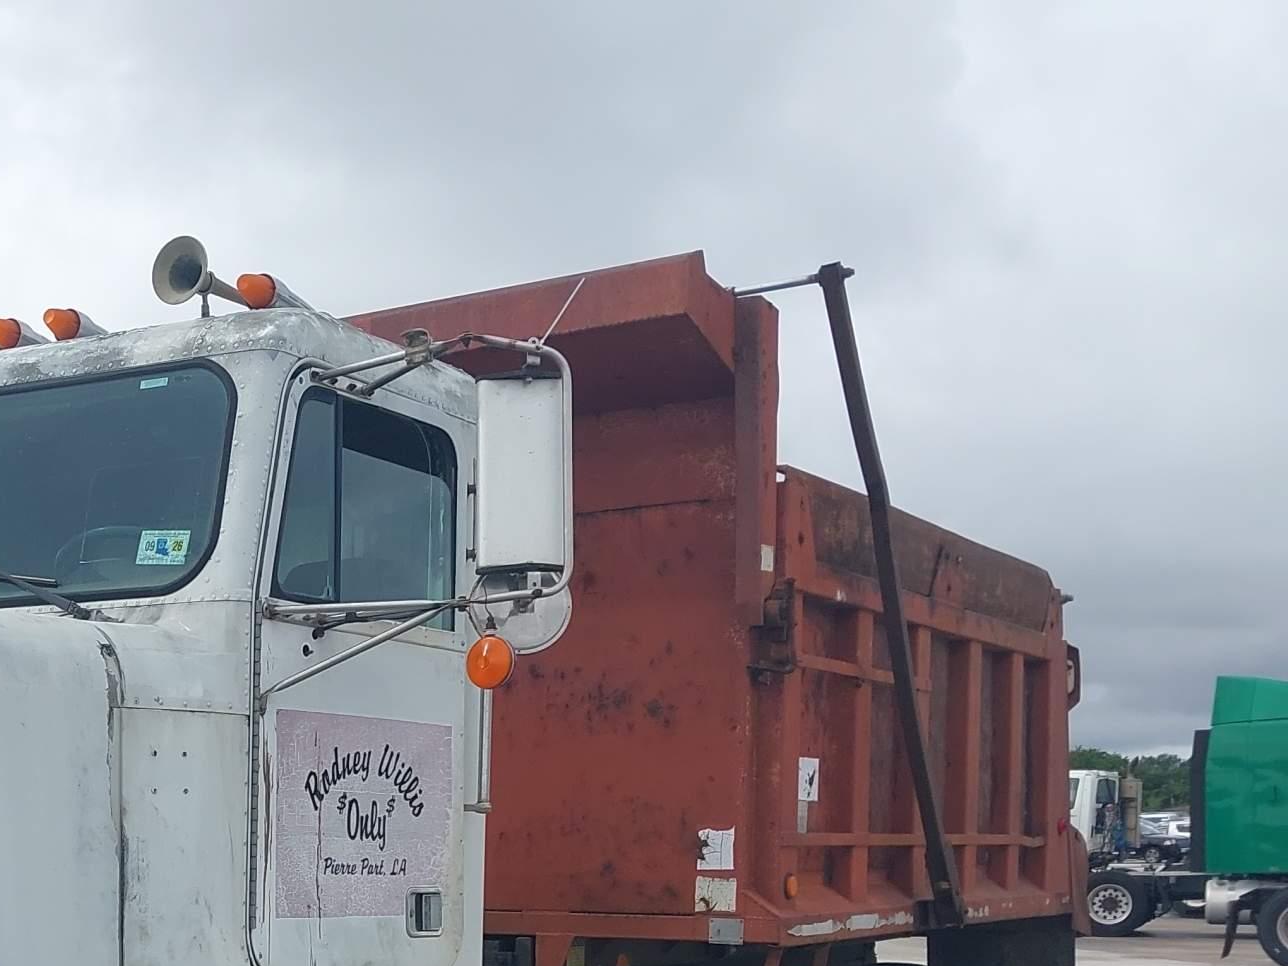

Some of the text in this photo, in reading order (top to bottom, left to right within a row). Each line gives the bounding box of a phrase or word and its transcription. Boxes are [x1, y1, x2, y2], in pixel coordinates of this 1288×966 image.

[145, 540, 184, 552] 09 26
[304, 744, 424, 817] Rodney Willis
[346, 798, 387, 851] Only
[323, 857, 407, 876] Pierre Part, LA
